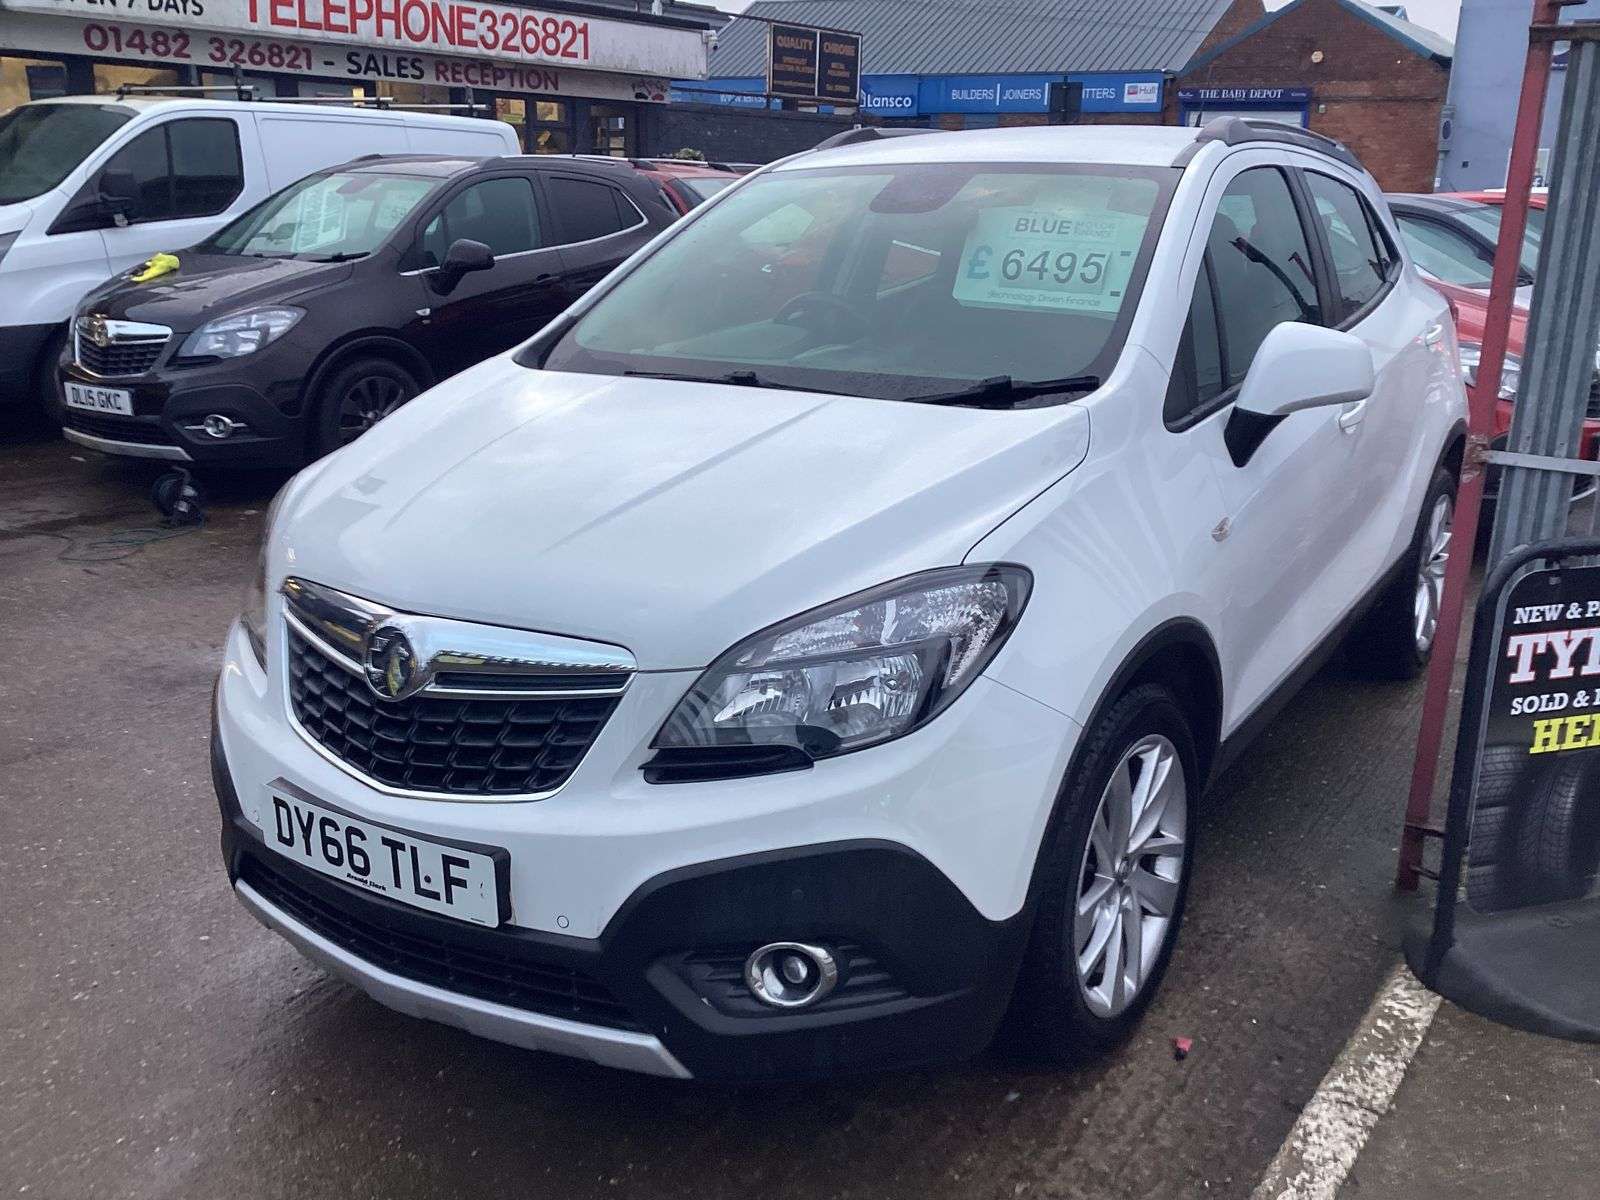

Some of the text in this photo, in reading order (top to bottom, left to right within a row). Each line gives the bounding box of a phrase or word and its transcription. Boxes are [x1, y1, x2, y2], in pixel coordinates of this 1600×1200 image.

[83, 23, 191, 58] 01482
[208, 36, 313, 70] 326821
[346, 51, 425, 80] SALES
[435, 59, 560, 91] RECEPTION
[867, 94, 912, 108] Lansco
[952, 89, 994, 100] BUILDERS
[1003, 88, 1041, 100] JOINERS
[1199, 89, 1219, 99] THE
[1221, 88, 1247, 99] BABY
[1249, 88, 1284, 99] DEPOT
[1015, 217, 1073, 235] BLUE
[966, 244, 1106, 284] £ 6495
[72, 387, 121, 410] DL15 GKC
[1513, 600, 1600, 625] NEW & P
[1510, 692, 1569, 715] SOLD
[1572, 690, 1590, 708] &
[273, 795, 470, 905] DY66 TLF
